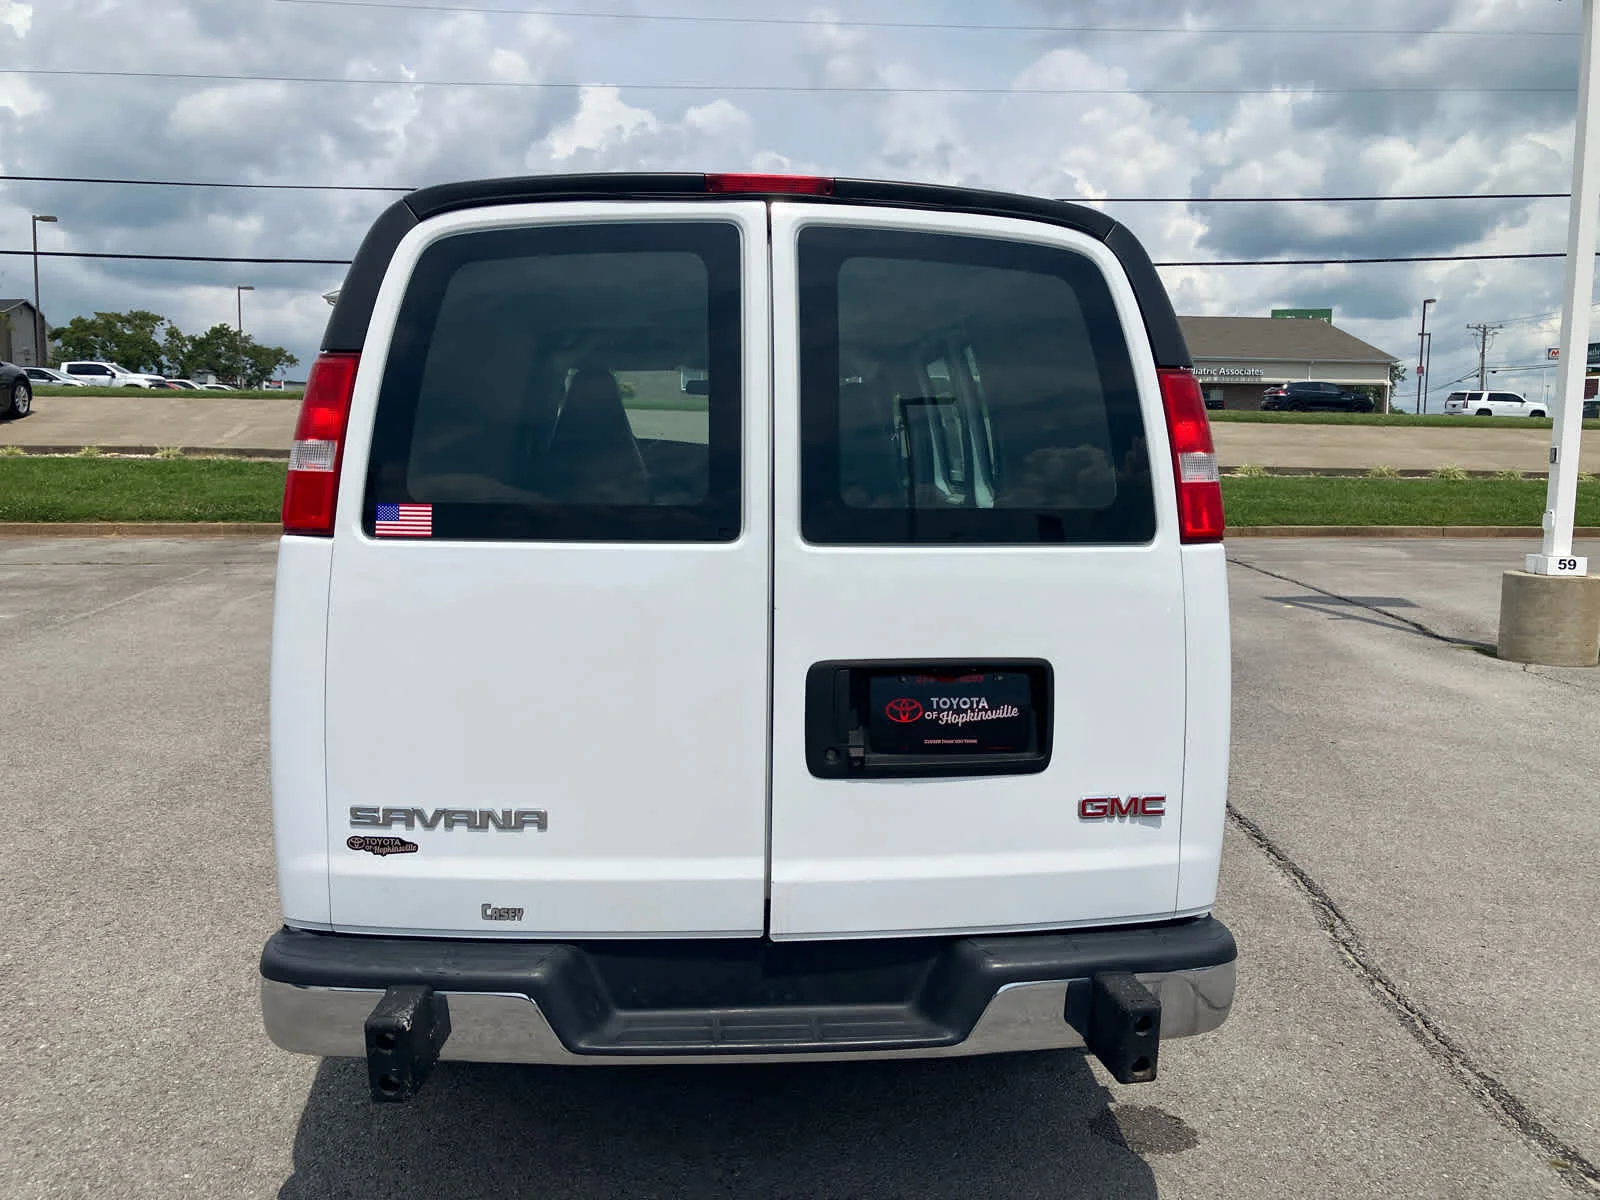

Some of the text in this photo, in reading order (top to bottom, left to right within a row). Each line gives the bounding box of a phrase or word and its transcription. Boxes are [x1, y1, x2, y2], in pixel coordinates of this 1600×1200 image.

[1219, 367, 1264, 376] Associates
[1557, 558, 1577, 570] 59
[930, 697, 989, 709] TOYOTA
[924, 704, 1019, 727] OF Hopkinsville
[1078, 795, 1166, 818] GMC
[349, 806, 548, 832] SAVANA
[364, 838, 401, 846] TOYOTA
